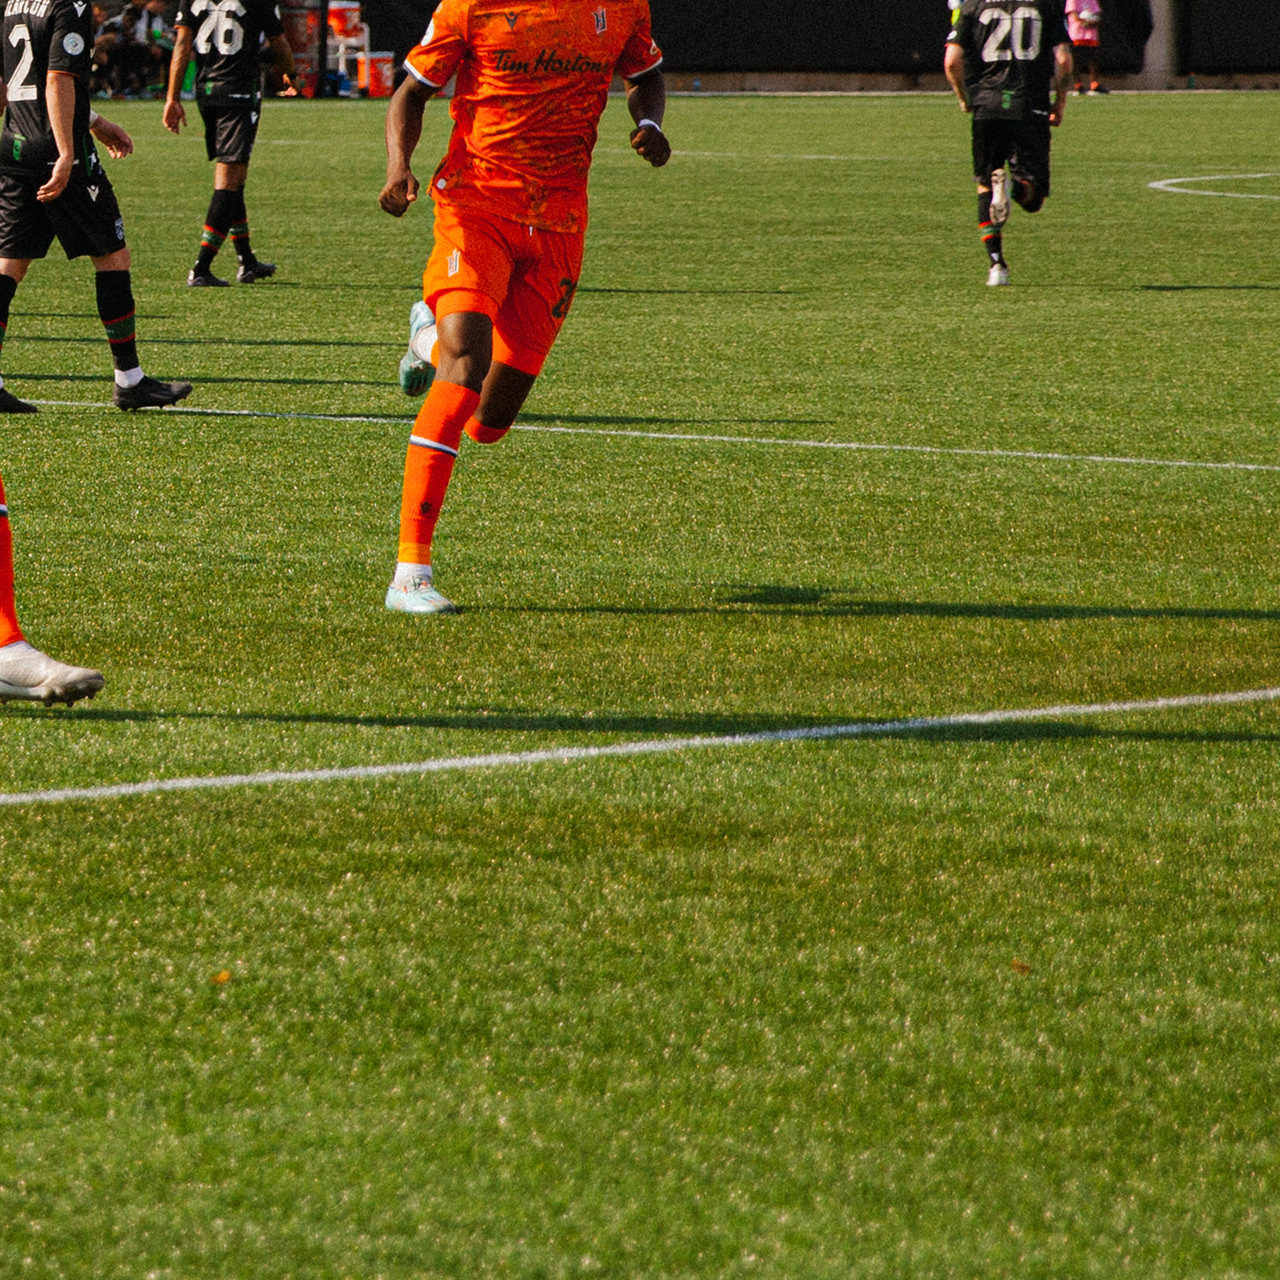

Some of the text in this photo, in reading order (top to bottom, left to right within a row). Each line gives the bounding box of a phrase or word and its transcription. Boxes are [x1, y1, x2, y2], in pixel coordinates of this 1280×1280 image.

[6, 23, 38, 102] 2
[492, 48, 529, 72] Tim
[979, 6, 1042, 63] 20
